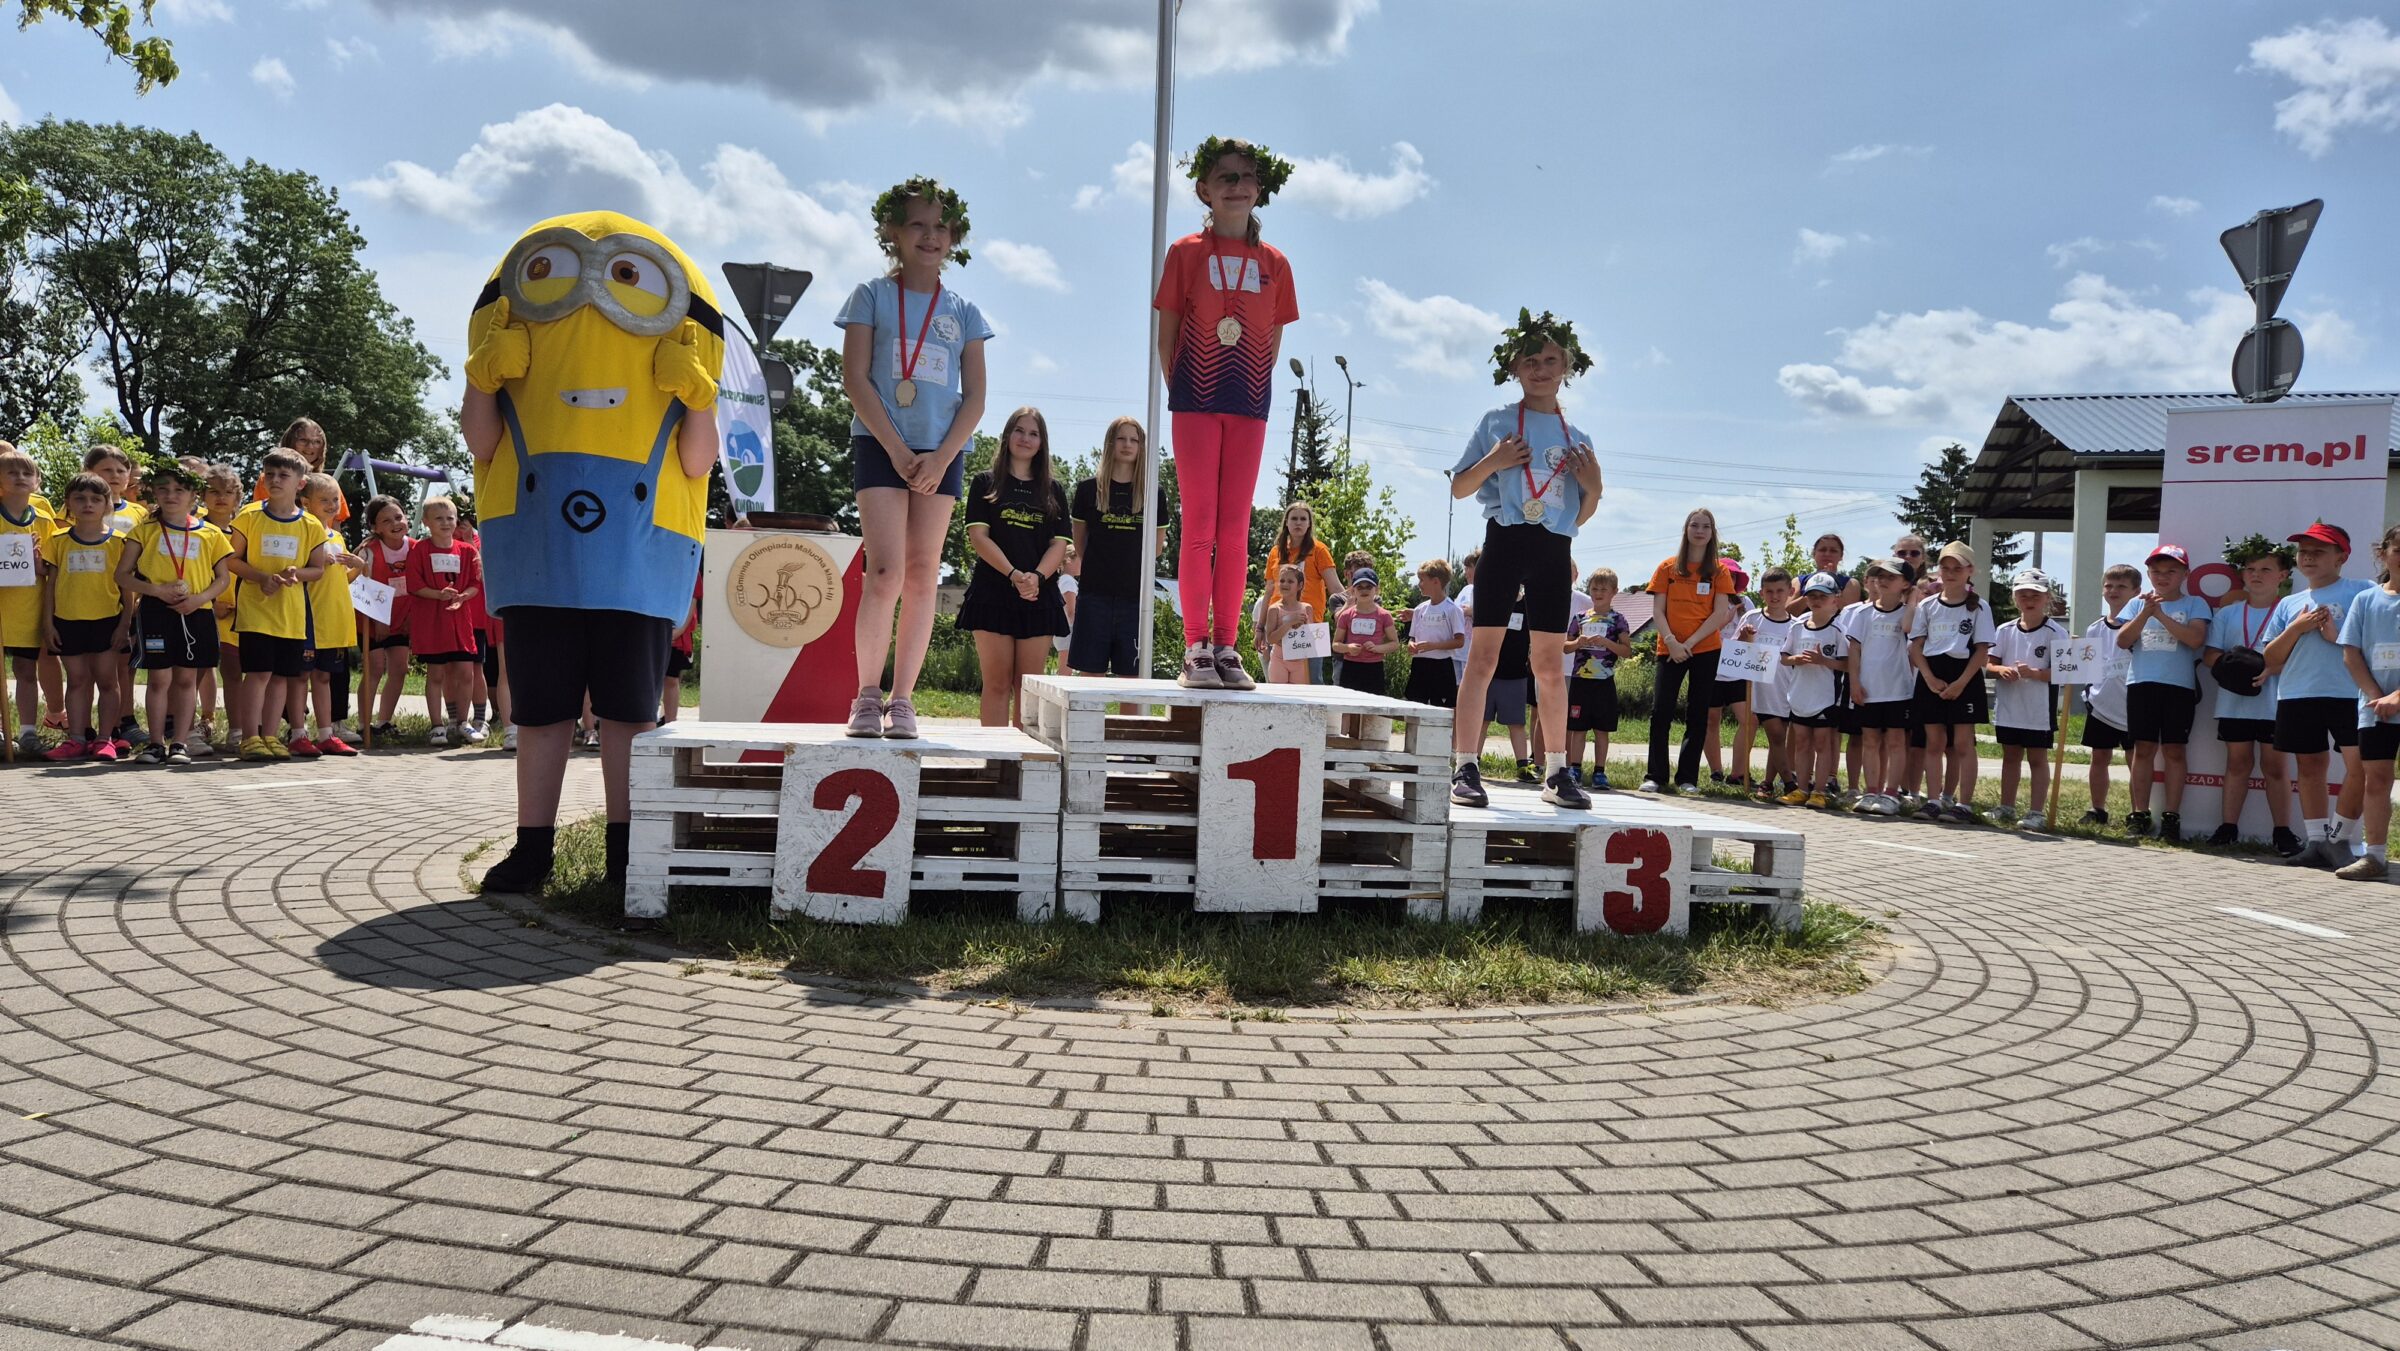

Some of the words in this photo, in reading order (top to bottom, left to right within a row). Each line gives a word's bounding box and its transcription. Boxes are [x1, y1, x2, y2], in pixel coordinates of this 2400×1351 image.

[2186, 434, 2367, 468] srem.pl
[736, 561, 751, 592] Gminna
[749, 542, 793, 561] Olimpiada
[794, 543, 827, 569] Malucha
[824, 567, 833, 586] klas
[1300, 630, 1306, 638] 2
[1734, 648, 1746, 656] SP
[2058, 660, 2078, 672] ŚREM
[1967, 703, 1974, 713] 3
[2184, 775, 2214, 786] RZĄD
[1227, 747, 1301, 860] 1
[805, 768, 900, 899] 2
[1602, 828, 1671, 935] 3
